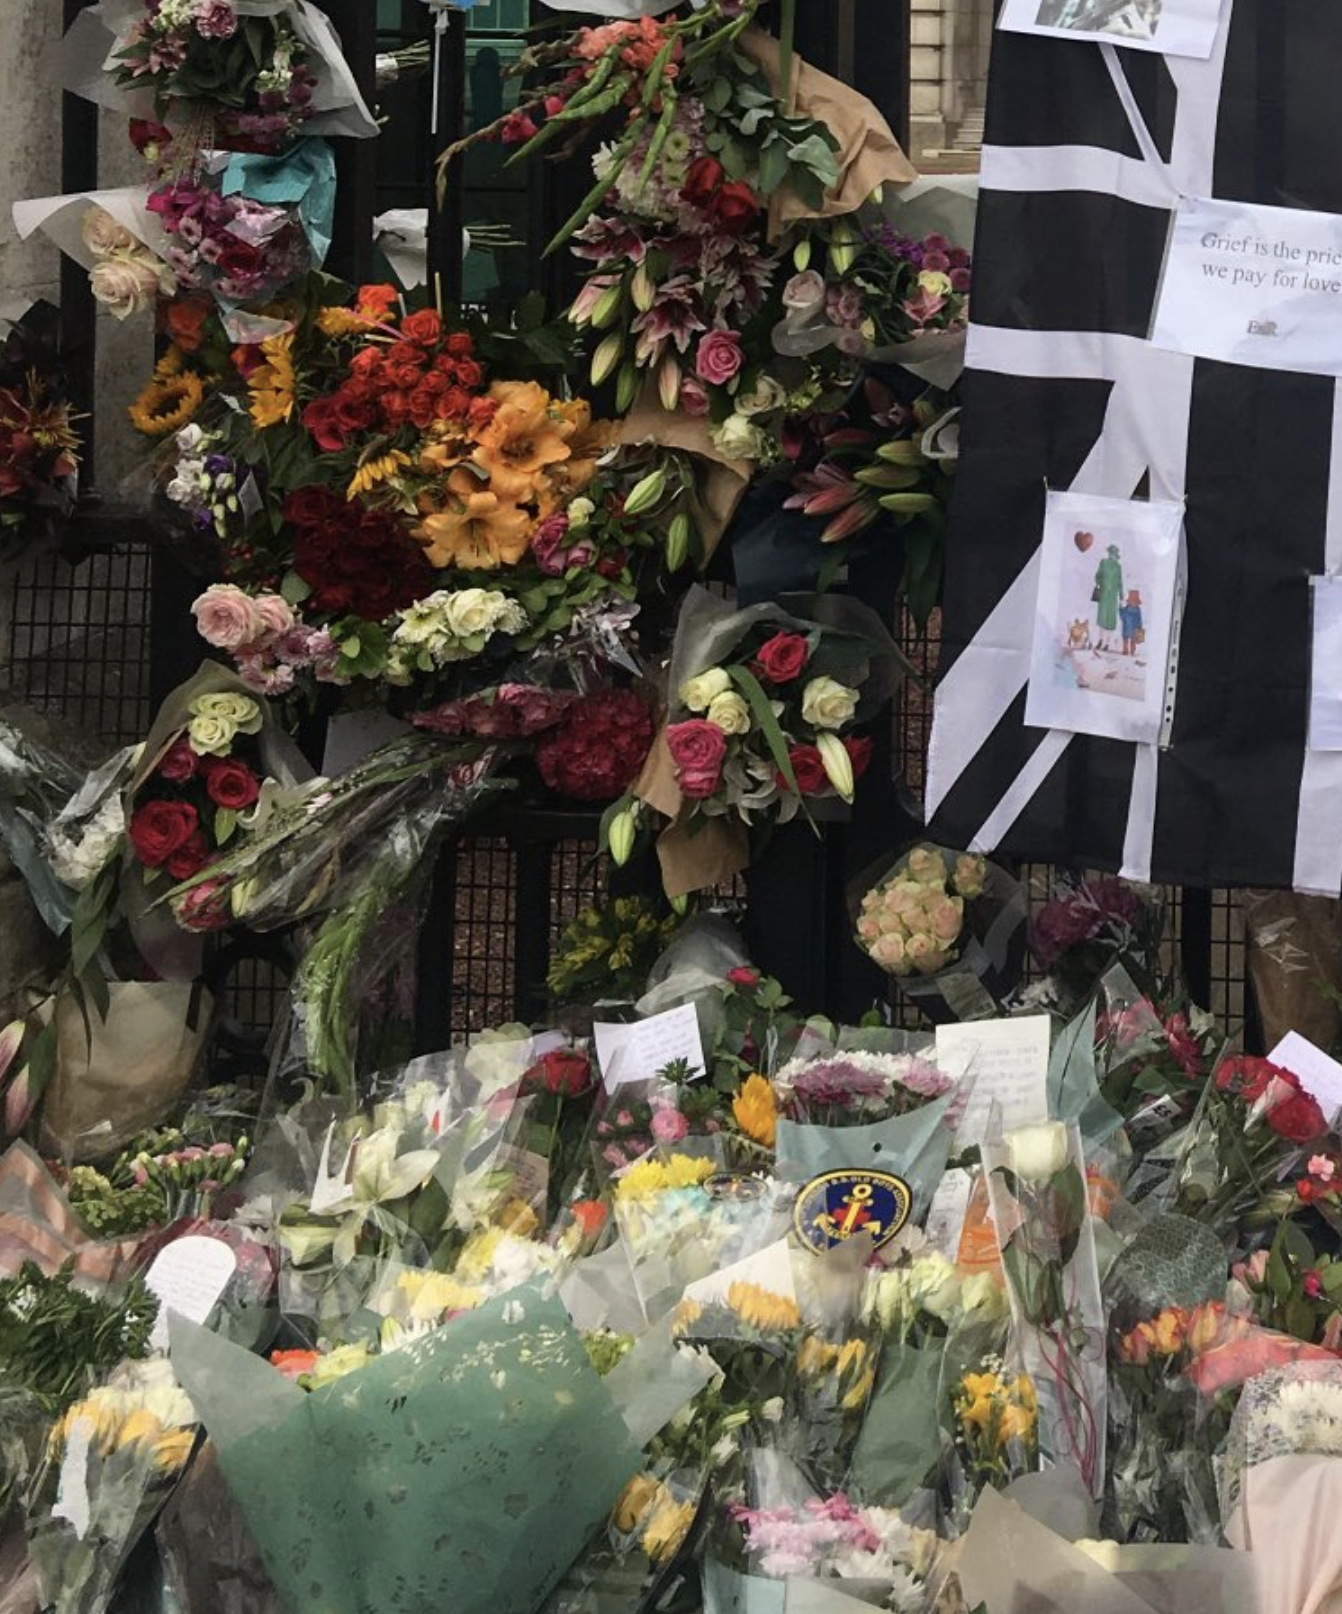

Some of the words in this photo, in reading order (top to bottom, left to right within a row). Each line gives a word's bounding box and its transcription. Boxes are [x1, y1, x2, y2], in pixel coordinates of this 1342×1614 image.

[1201, 232, 1251, 253] Grief
[1255, 238, 1268, 255] is
[1274, 241, 1300, 260] the
[1202, 263, 1228, 279] we
[1232, 269, 1268, 288] pay
[1273, 270, 1298, 288] for
[1303, 273, 1342, 293] love
